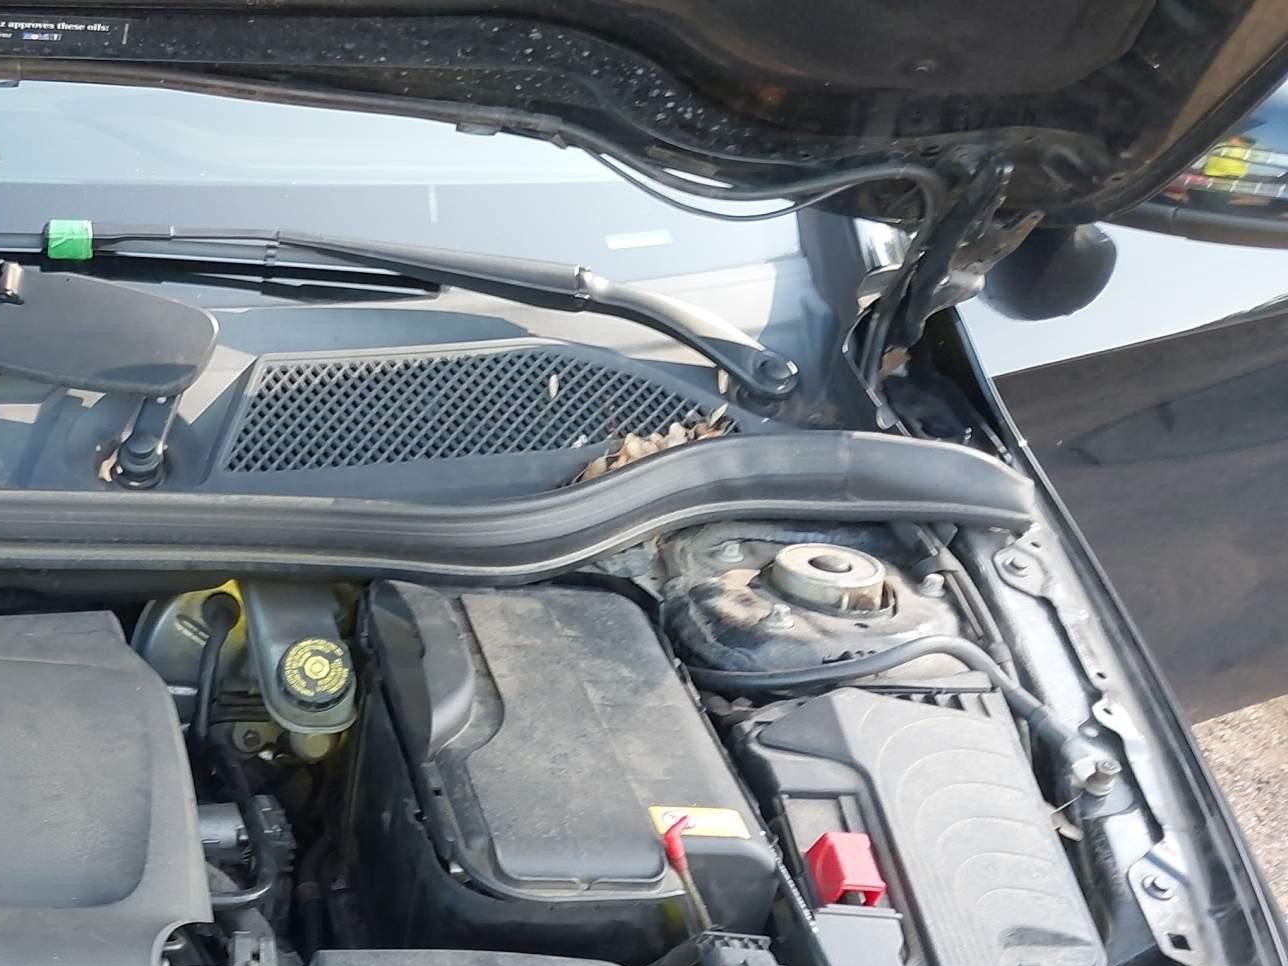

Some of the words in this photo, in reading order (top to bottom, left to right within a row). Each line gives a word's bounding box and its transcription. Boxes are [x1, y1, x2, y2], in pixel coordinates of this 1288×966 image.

[7, 21, 55, 30] approves
[56, 21, 86, 31] these
[86, 23, 111, 32] oils:
